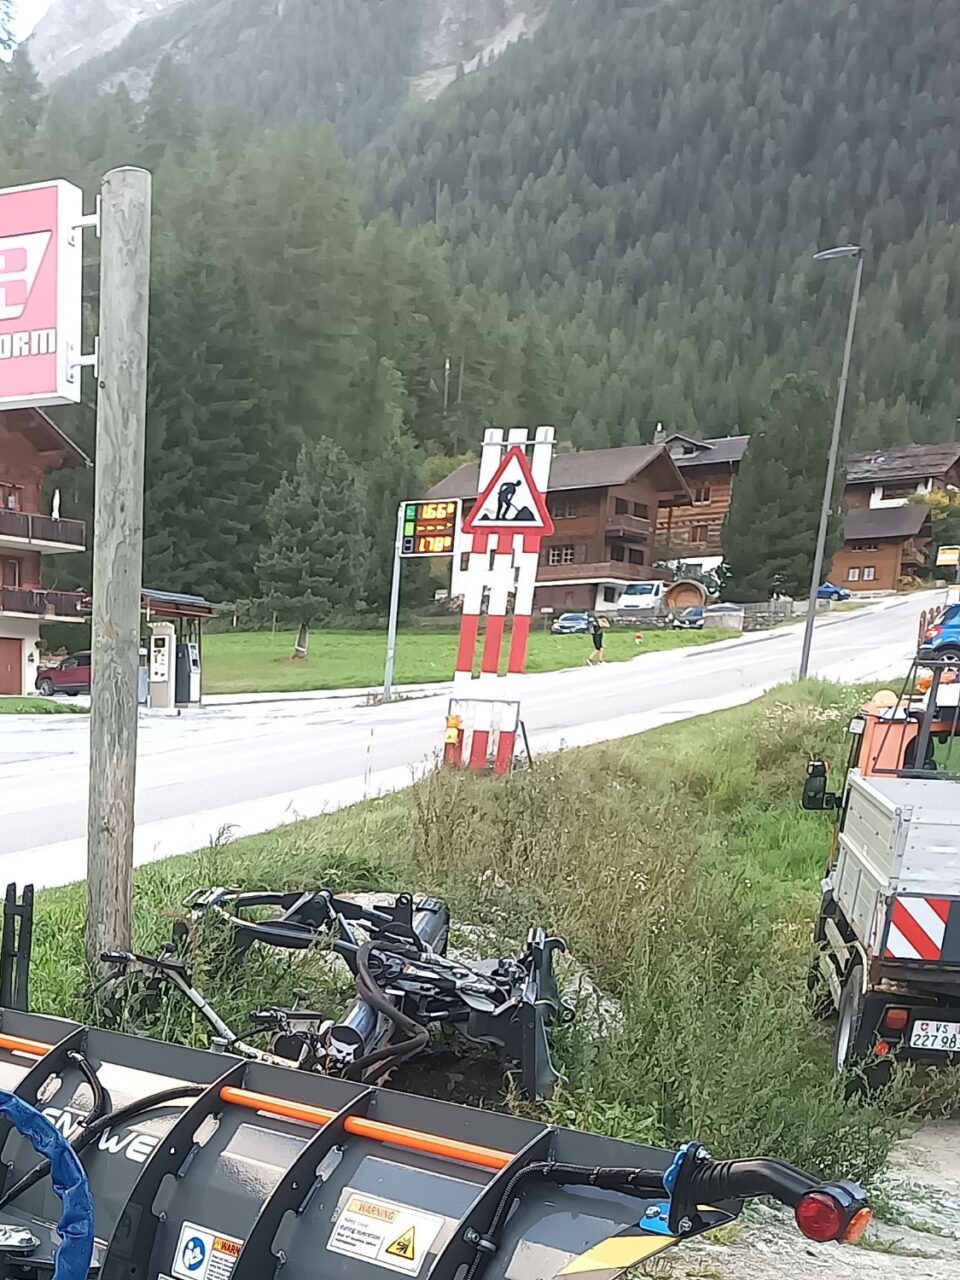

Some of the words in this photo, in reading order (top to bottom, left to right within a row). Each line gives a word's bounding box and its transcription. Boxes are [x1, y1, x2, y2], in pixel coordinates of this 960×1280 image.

[936, 1023, 949, 1034] VS
[913, 1034, 938, 1047] 227
[941, 1035, 960, 1049] 98
[358, 1202, 395, 1221] WARNING
[221, 1241, 241, 1255] WARN
